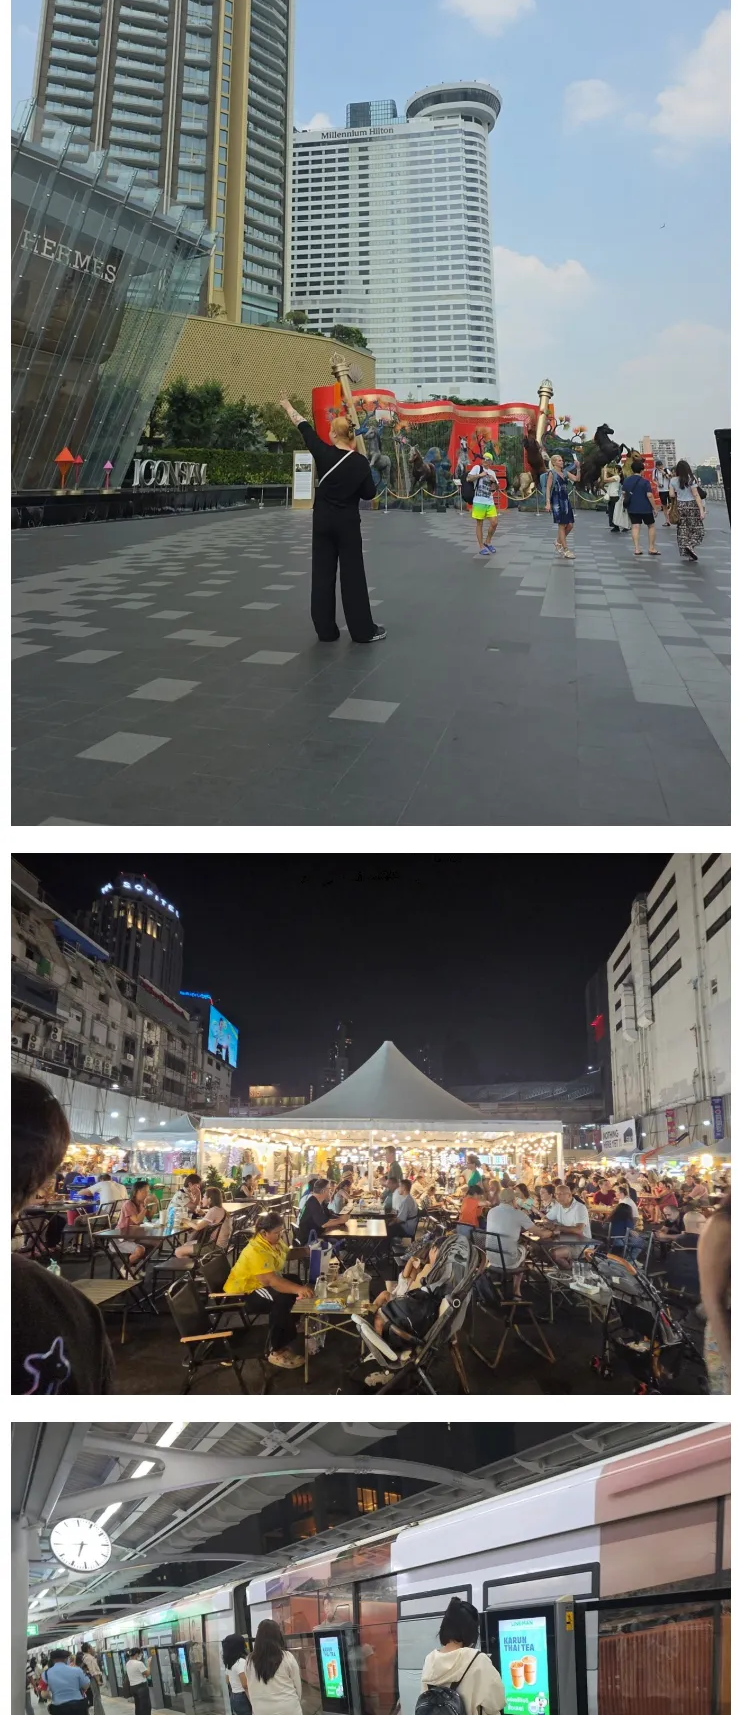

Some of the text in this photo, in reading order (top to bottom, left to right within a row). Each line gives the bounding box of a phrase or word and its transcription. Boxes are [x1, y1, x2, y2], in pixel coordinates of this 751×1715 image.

[321, 127, 394, 140] Millennium Hilton
[503, 1636, 527, 1645] KARUN
[504, 1643, 535, 1652] THAI TEA
